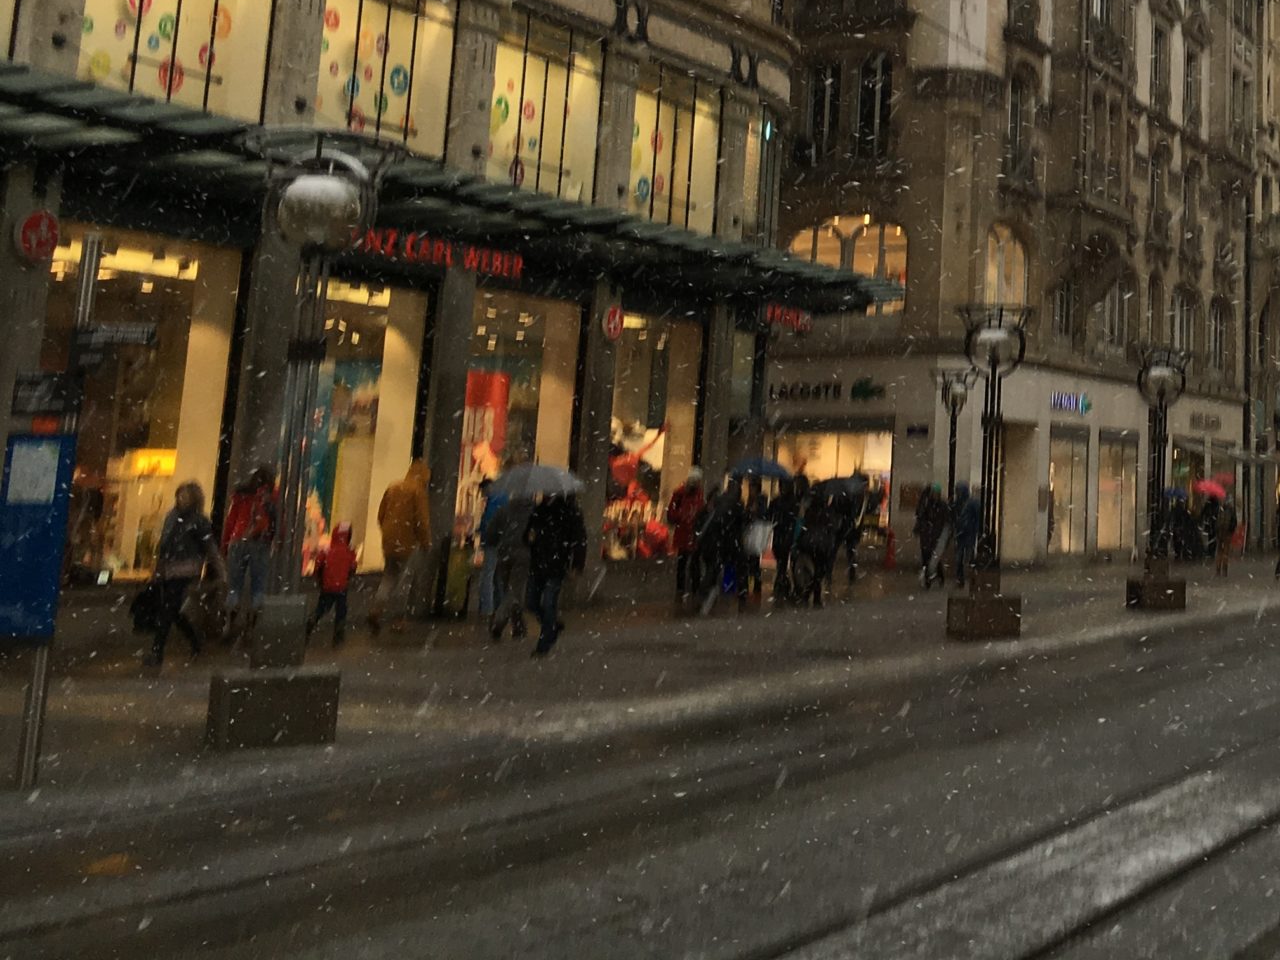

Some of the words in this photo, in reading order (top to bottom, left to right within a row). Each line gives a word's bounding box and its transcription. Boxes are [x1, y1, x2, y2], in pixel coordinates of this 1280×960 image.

[405, 233, 453, 268] CARL
[463, 247, 524, 278] WEBER
[769, 384, 842, 400] LACOSTE
